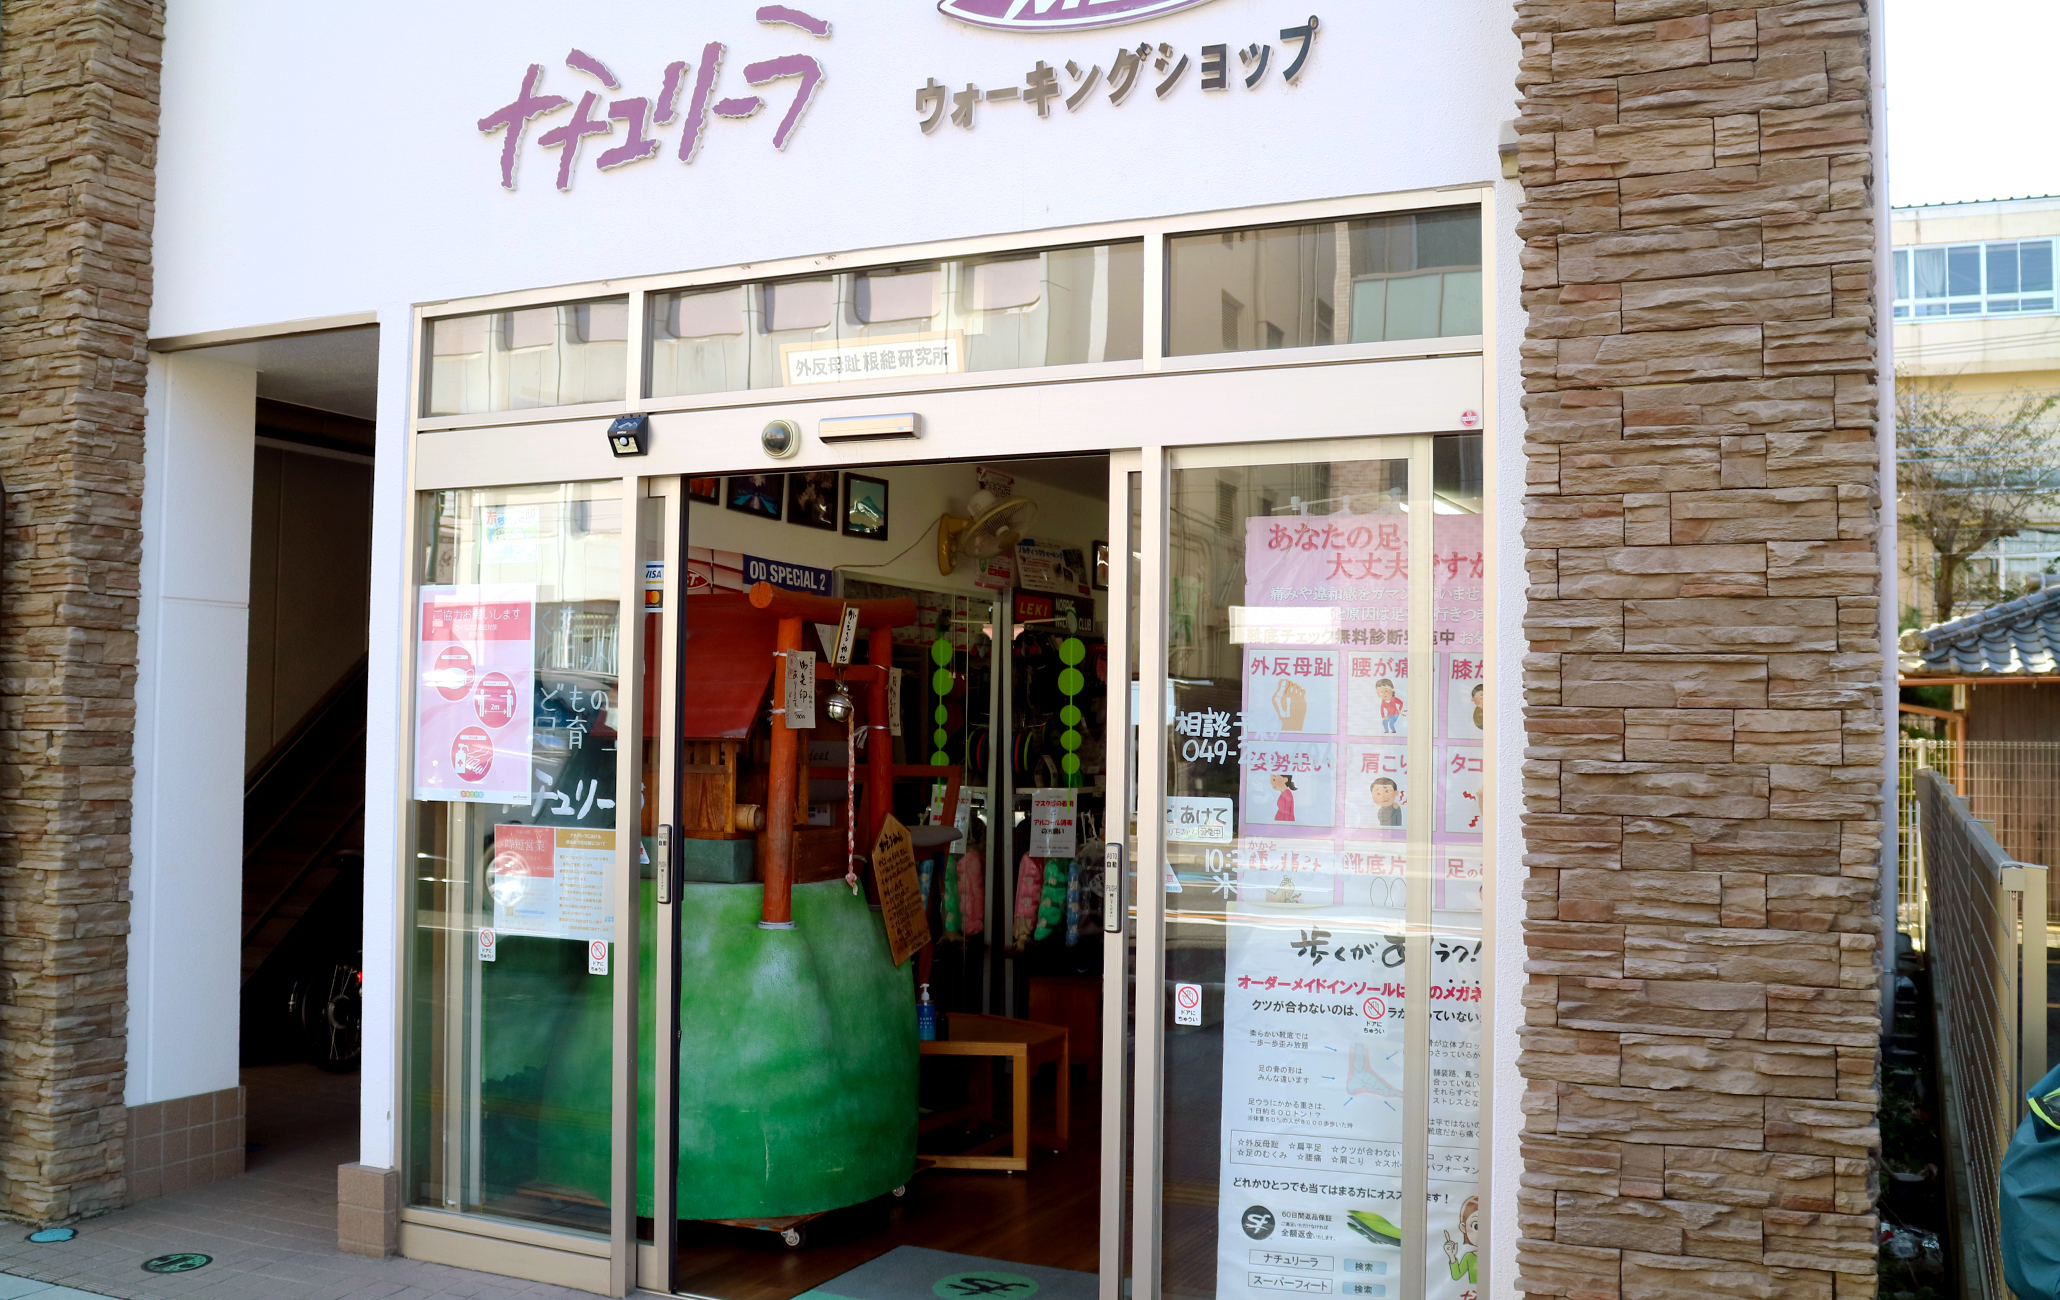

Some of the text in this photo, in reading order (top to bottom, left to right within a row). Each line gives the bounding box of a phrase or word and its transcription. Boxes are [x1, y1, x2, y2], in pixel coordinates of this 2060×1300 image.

[916, 15, 1322, 135] ウォーキングショップ
[478, 5, 832, 191] ナチュリーラ
[795, 346, 950, 378] 外反母趾根絶研究所
[750, 560, 826, 591] OD SPECIAL 2
[433, 608, 521, 621] ご協力お願いします
[1020, 601, 1048, 616] LEKI
[1250, 656, 1334, 678] 外反母趾
[1180, 805, 1228, 825] あけて
[1248, 841, 1277, 850] かかと
[1363, 1027, 1385, 1035] ちゅうい
[1366, 1020, 1383, 1028] ドアに
[1249, 1029, 1309, 1040] 柔らかい靴底では
[1249, 1039, 1309, 1050] 一歩一歩歪み放題
[1258, 1064, 1303, 1075] 足の骨の形は
[1257, 1074, 1310, 1084] みんな違います
[1247, 1097, 1326, 1111] 足ウラにかかる重さは、
[1281, 1210, 1333, 1223] 60日間返品保証
[1263, 1252, 1374, 1273] ナチュリーラ 検索
[1253, 1274, 1373, 1296] スーパーフィート 検索
